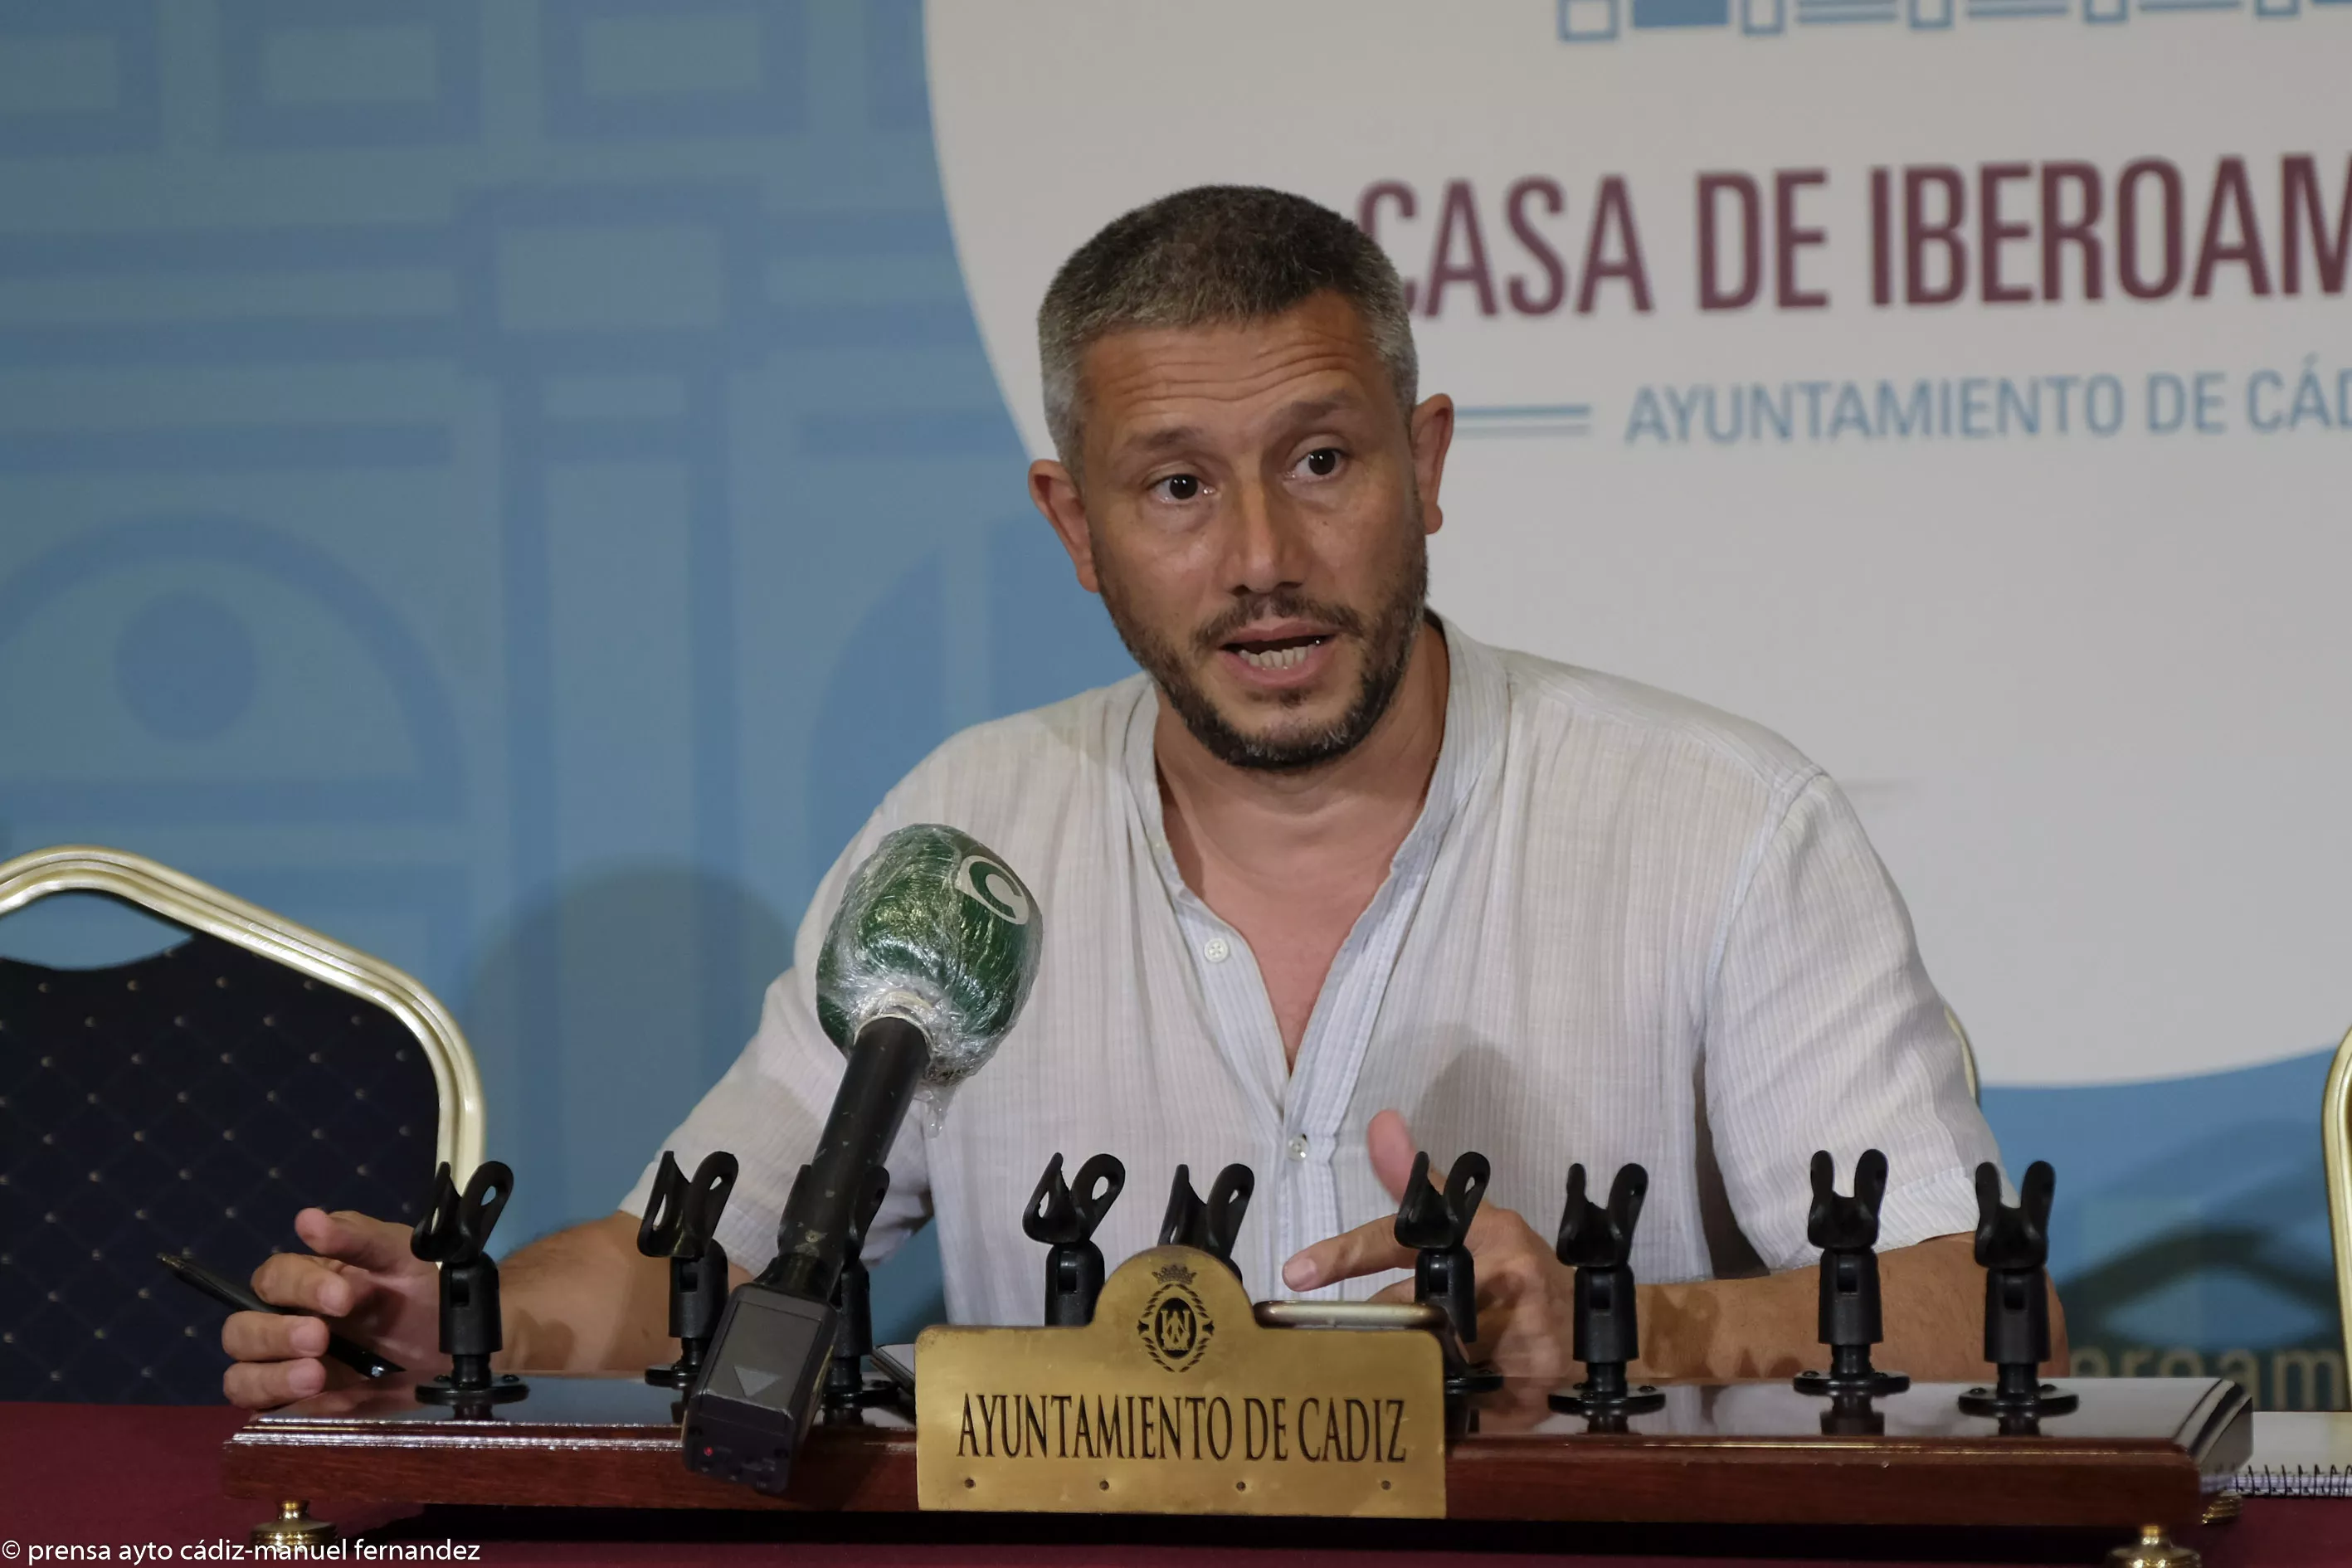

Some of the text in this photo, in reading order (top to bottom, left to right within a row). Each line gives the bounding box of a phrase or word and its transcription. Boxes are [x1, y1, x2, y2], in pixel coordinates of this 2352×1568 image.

[1696, 169, 1829, 311] DE
[1624, 373, 2126, 445] AYUNTAMIENTO
[2146, 370, 2227, 437] DE
[957, 1393, 1407, 1463] AYUNTAMIENTO DE CADIZ
